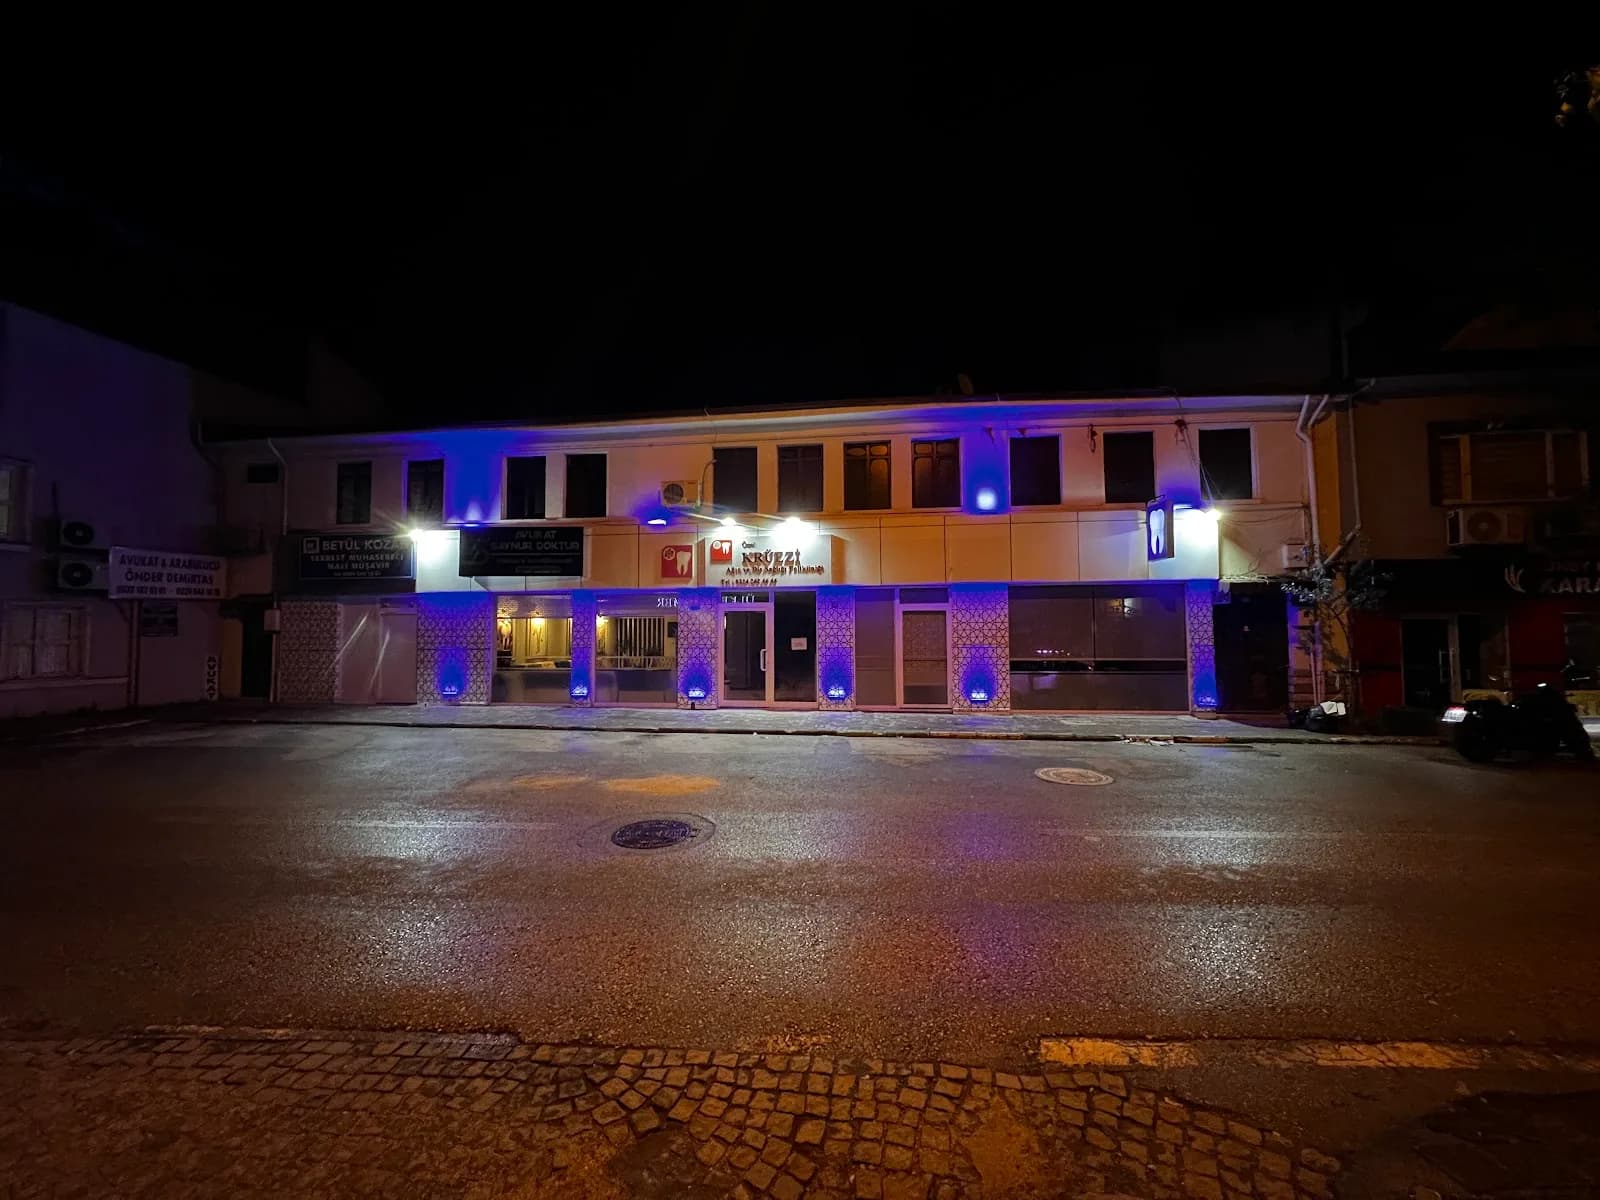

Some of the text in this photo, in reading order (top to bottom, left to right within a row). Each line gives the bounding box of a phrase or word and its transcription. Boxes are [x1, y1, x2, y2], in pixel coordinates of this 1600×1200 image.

[322, 537, 360, 551] BETÜL
[120, 554, 158, 567] AVUKAT
[125, 568, 163, 583] ÖNDER
